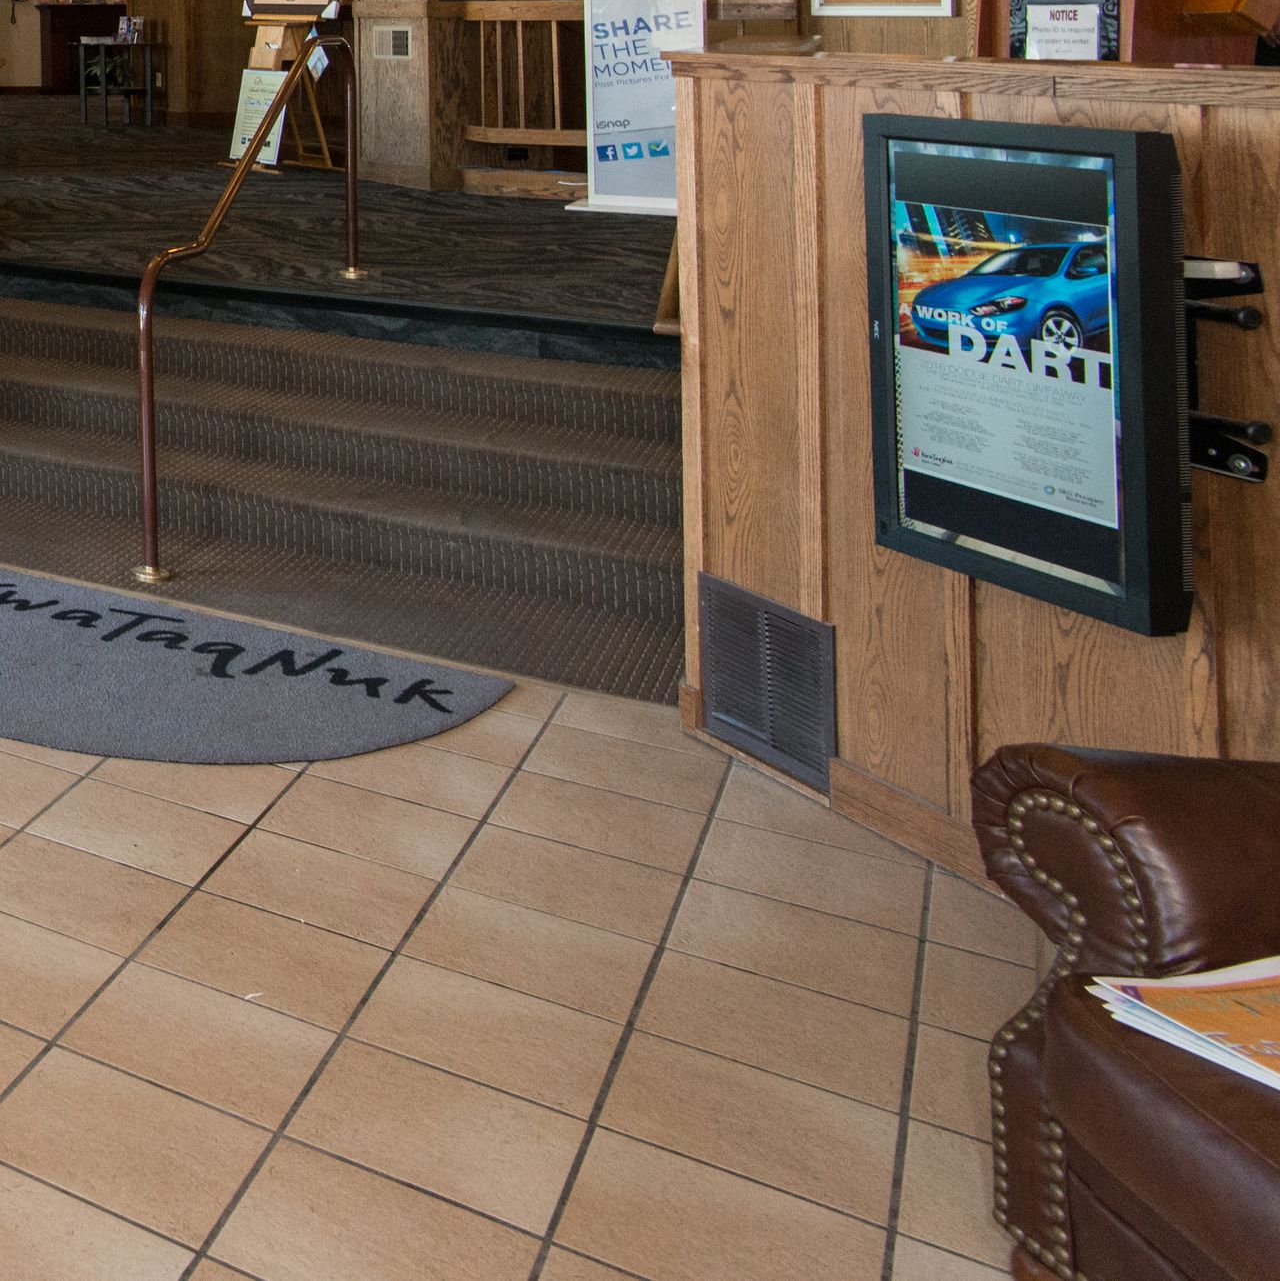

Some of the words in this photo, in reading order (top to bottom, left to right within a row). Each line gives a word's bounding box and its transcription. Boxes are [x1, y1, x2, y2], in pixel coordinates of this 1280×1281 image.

[592, 10, 693, 40] SHARE
[1049, 9, 1078, 22] NOTICE
[1067, 26, 1095, 34] required
[594, 38, 650, 61] THE
[594, 80, 614, 89] Post
[616, 76, 652, 86] Pictures
[596, 118, 631, 130] iSnap
[899, 303, 912, 317] A
[915, 305, 976, 329] WORK
[981, 317, 1008, 333] OF
[948, 324, 1112, 390] DART
[918, 358, 948, 372] 2016
[948, 362, 989, 382] DODGE
[993, 374, 1024, 389] DART
[1026, 382, 1087, 403] GIVEAWAY
